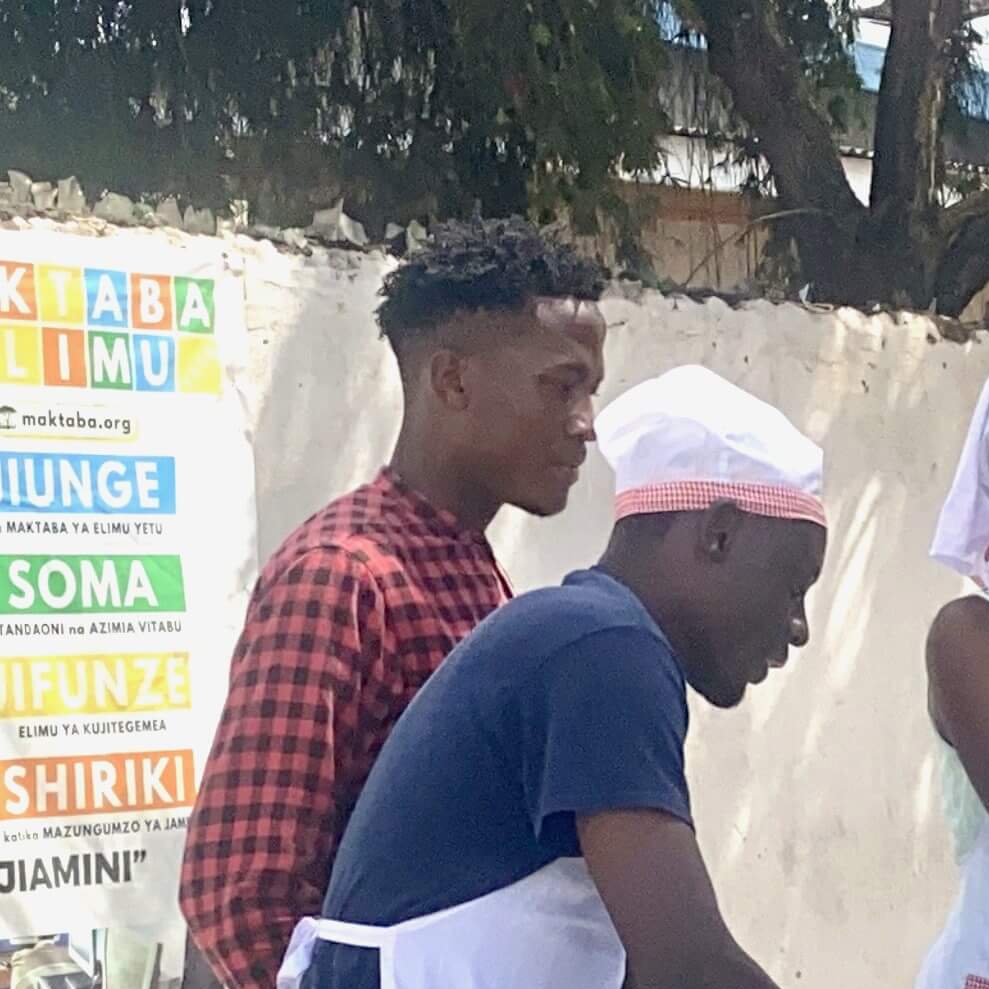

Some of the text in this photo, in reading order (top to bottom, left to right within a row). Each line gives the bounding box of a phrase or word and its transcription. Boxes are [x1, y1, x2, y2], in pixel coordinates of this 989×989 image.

[0, 265, 211, 329] KTABA
[6, 330, 169, 386] LIMU
[22, 409, 131, 434] maktaba.org
[0, 456, 161, 509] IUNGE
[6, 521, 163, 535] MAKTABA YA ELIMU YETU
[8, 558, 160, 610] SOMA
[69, 625, 85, 635] na
[89, 622, 135, 634] AZIMIA
[138, 620, 182, 633] VITABU
[0, 658, 186, 710] IFUNZE
[18, 719, 167, 738] ELIMU YA KUJITEGEMEA
[4, 755, 187, 815] SHIRIKI
[4, 830, 39, 843] katika
[43, 820, 141, 839] MAZUNGUMZO
[144, 818, 162, 833] YA
